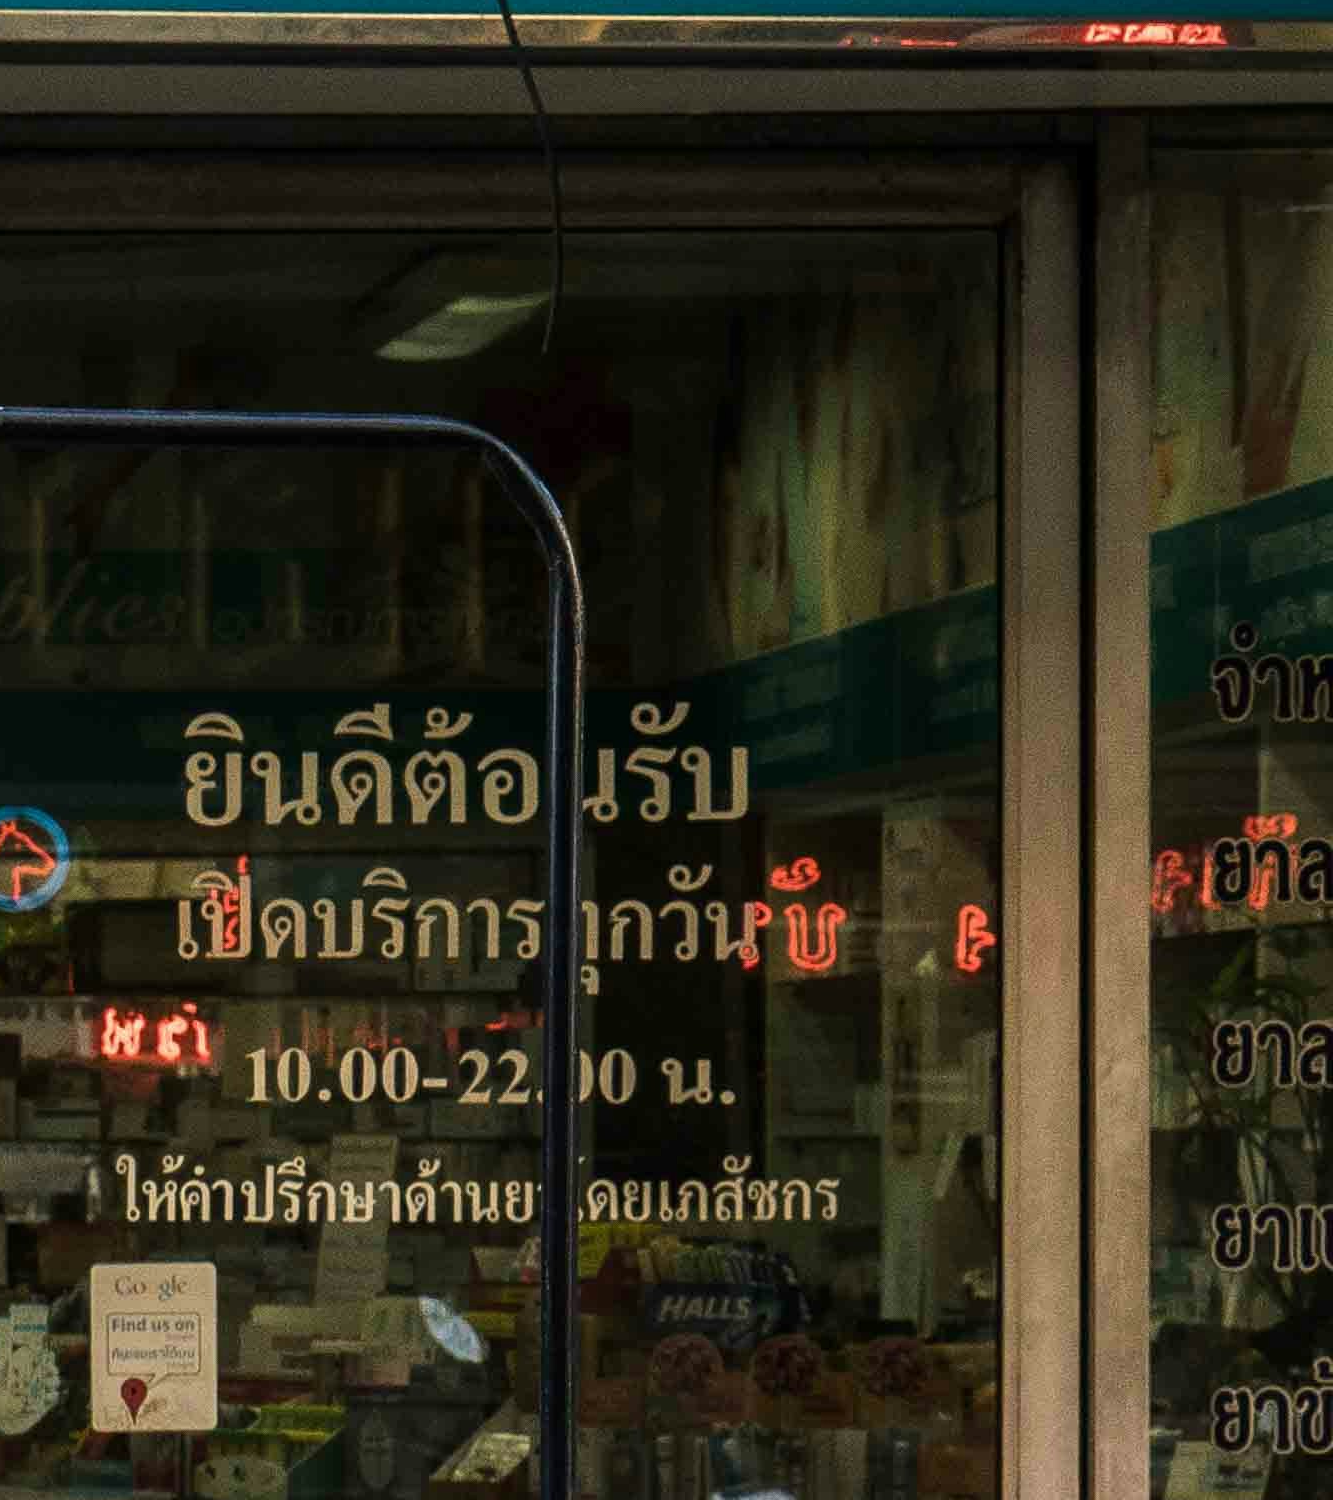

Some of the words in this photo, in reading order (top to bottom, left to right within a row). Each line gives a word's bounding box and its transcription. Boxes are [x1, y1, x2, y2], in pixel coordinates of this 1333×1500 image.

[177, 863, 759, 996] เปิดบริการุกวัน
[659, 1059, 736, 1105] น.
[115, 1154, 841, 1224] ให้คำปรึกษาด้านยดยเภสัชกร
[113, 1273, 190, 1302] Gogle
[111, 1317, 148, 1333] Find
[150, 1318, 171, 1333] us
[174, 1318, 196, 1332] on
[657, 1294, 753, 1324] HALLS
